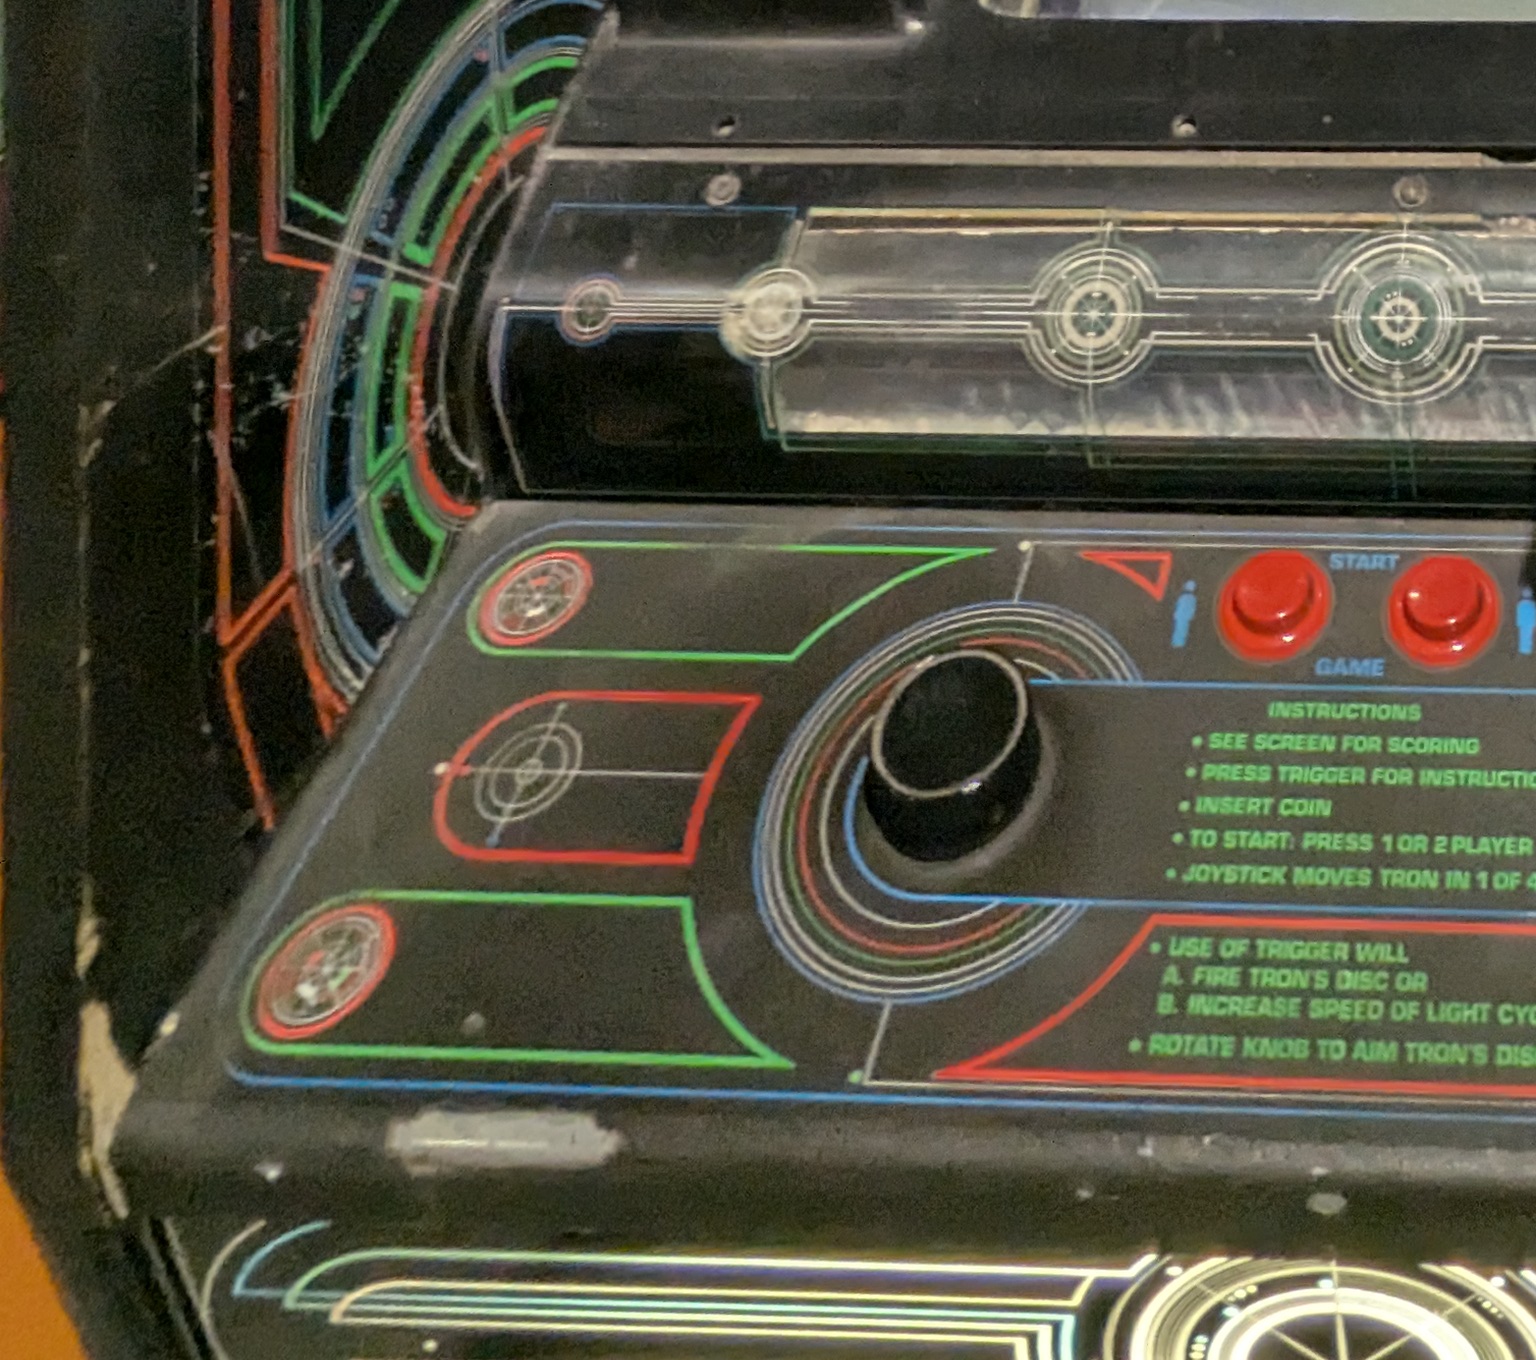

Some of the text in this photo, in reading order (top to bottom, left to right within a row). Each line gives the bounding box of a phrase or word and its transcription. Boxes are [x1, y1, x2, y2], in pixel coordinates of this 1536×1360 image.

[1329, 553, 1399, 571] START
[1315, 657, 1386, 677] GAME
[1268, 701, 1422, 721] INSTRUCTIONS
[1208, 733, 1480, 755] SEE SCREEN FOR SCORING
[1201, 764, 1272, 781] PRESS
[1278, 765, 1366, 785] TRIGGER
[1371, 767, 1413, 786] FOR
[1195, 796, 1332, 818] INSERT COIN
[1189, 829, 1218, 848] TO
[1302, 832, 1373, 853] PRESS
[1381, 834, 1393, 853] 1
[1397, 834, 1429, 854] OR
[1433, 836, 1448, 854] 2
[1451, 836, 1533, 857] PLAYER
[1181, 864, 1288, 885] JOYSTICK
[1292, 865, 1372, 887] MOVES
[1380, 868, 1439, 889] TRON
[1445, 870, 1471, 890] IN
[1476, 871, 1488, 890] 1
[1492, 871, 1522, 891] OF
[1168, 937, 1409, 963] USE OF TRIGGER WILL
[1192, 965, 1243, 987] FIRE
[1250, 967, 1329, 989] TRON'S
[1335, 969, 1389, 991] DISC
[1395, 970, 1429, 993] OR
[1187, 993, 1301, 1018] INCREASE
[1308, 997, 1384, 1021] SPEED
[1390, 1000, 1421, 1022] OF
[1426, 1001, 1493, 1023] LIGHT
[1148, 1033, 1235, 1057] ROTATE
[1242, 1035, 1310, 1059] KNOB
[1317, 1038, 1347, 1060] TO
[1352, 1039, 1399, 1063] AIM
[1404, 1041, 1489, 1066] TRON'S
